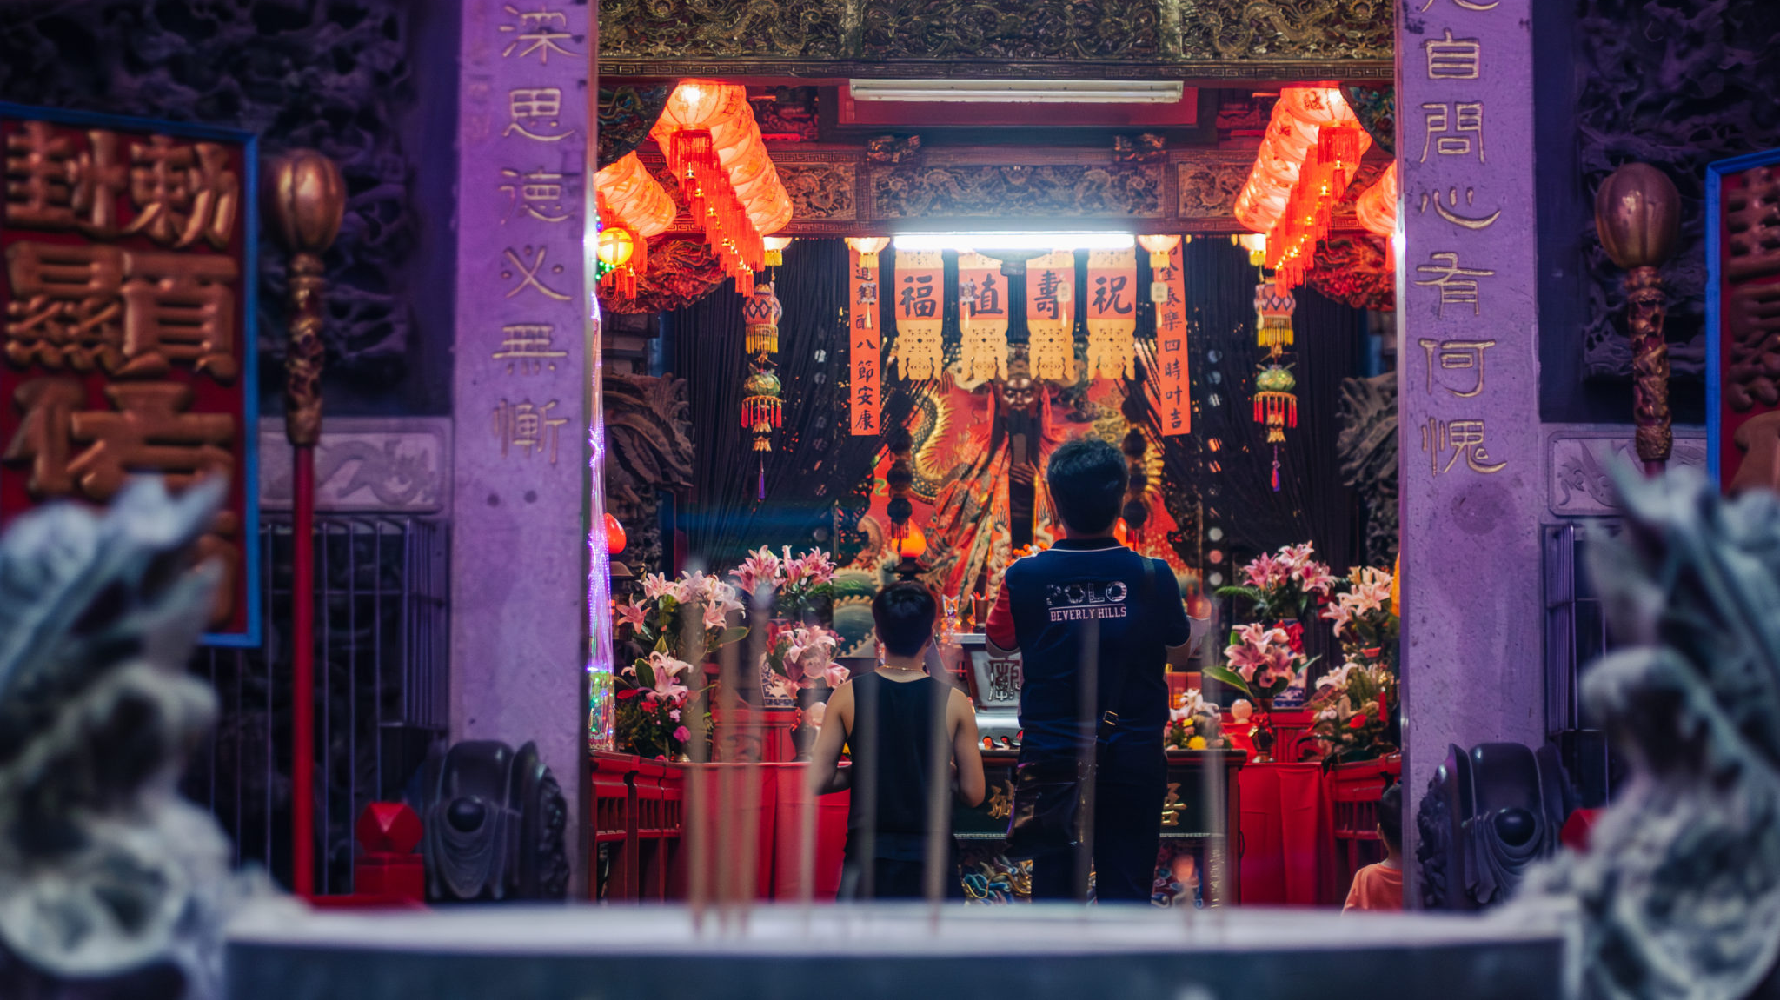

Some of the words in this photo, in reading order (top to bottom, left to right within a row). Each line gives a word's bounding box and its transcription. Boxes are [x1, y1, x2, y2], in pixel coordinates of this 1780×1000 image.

[1415, 0, 1507, 477] 自問心有何愧
[1046, 581, 1127, 605] POLO
[1050, 608, 1094, 622] BEVERLY
[1098, 606, 1127, 619] HILLS
